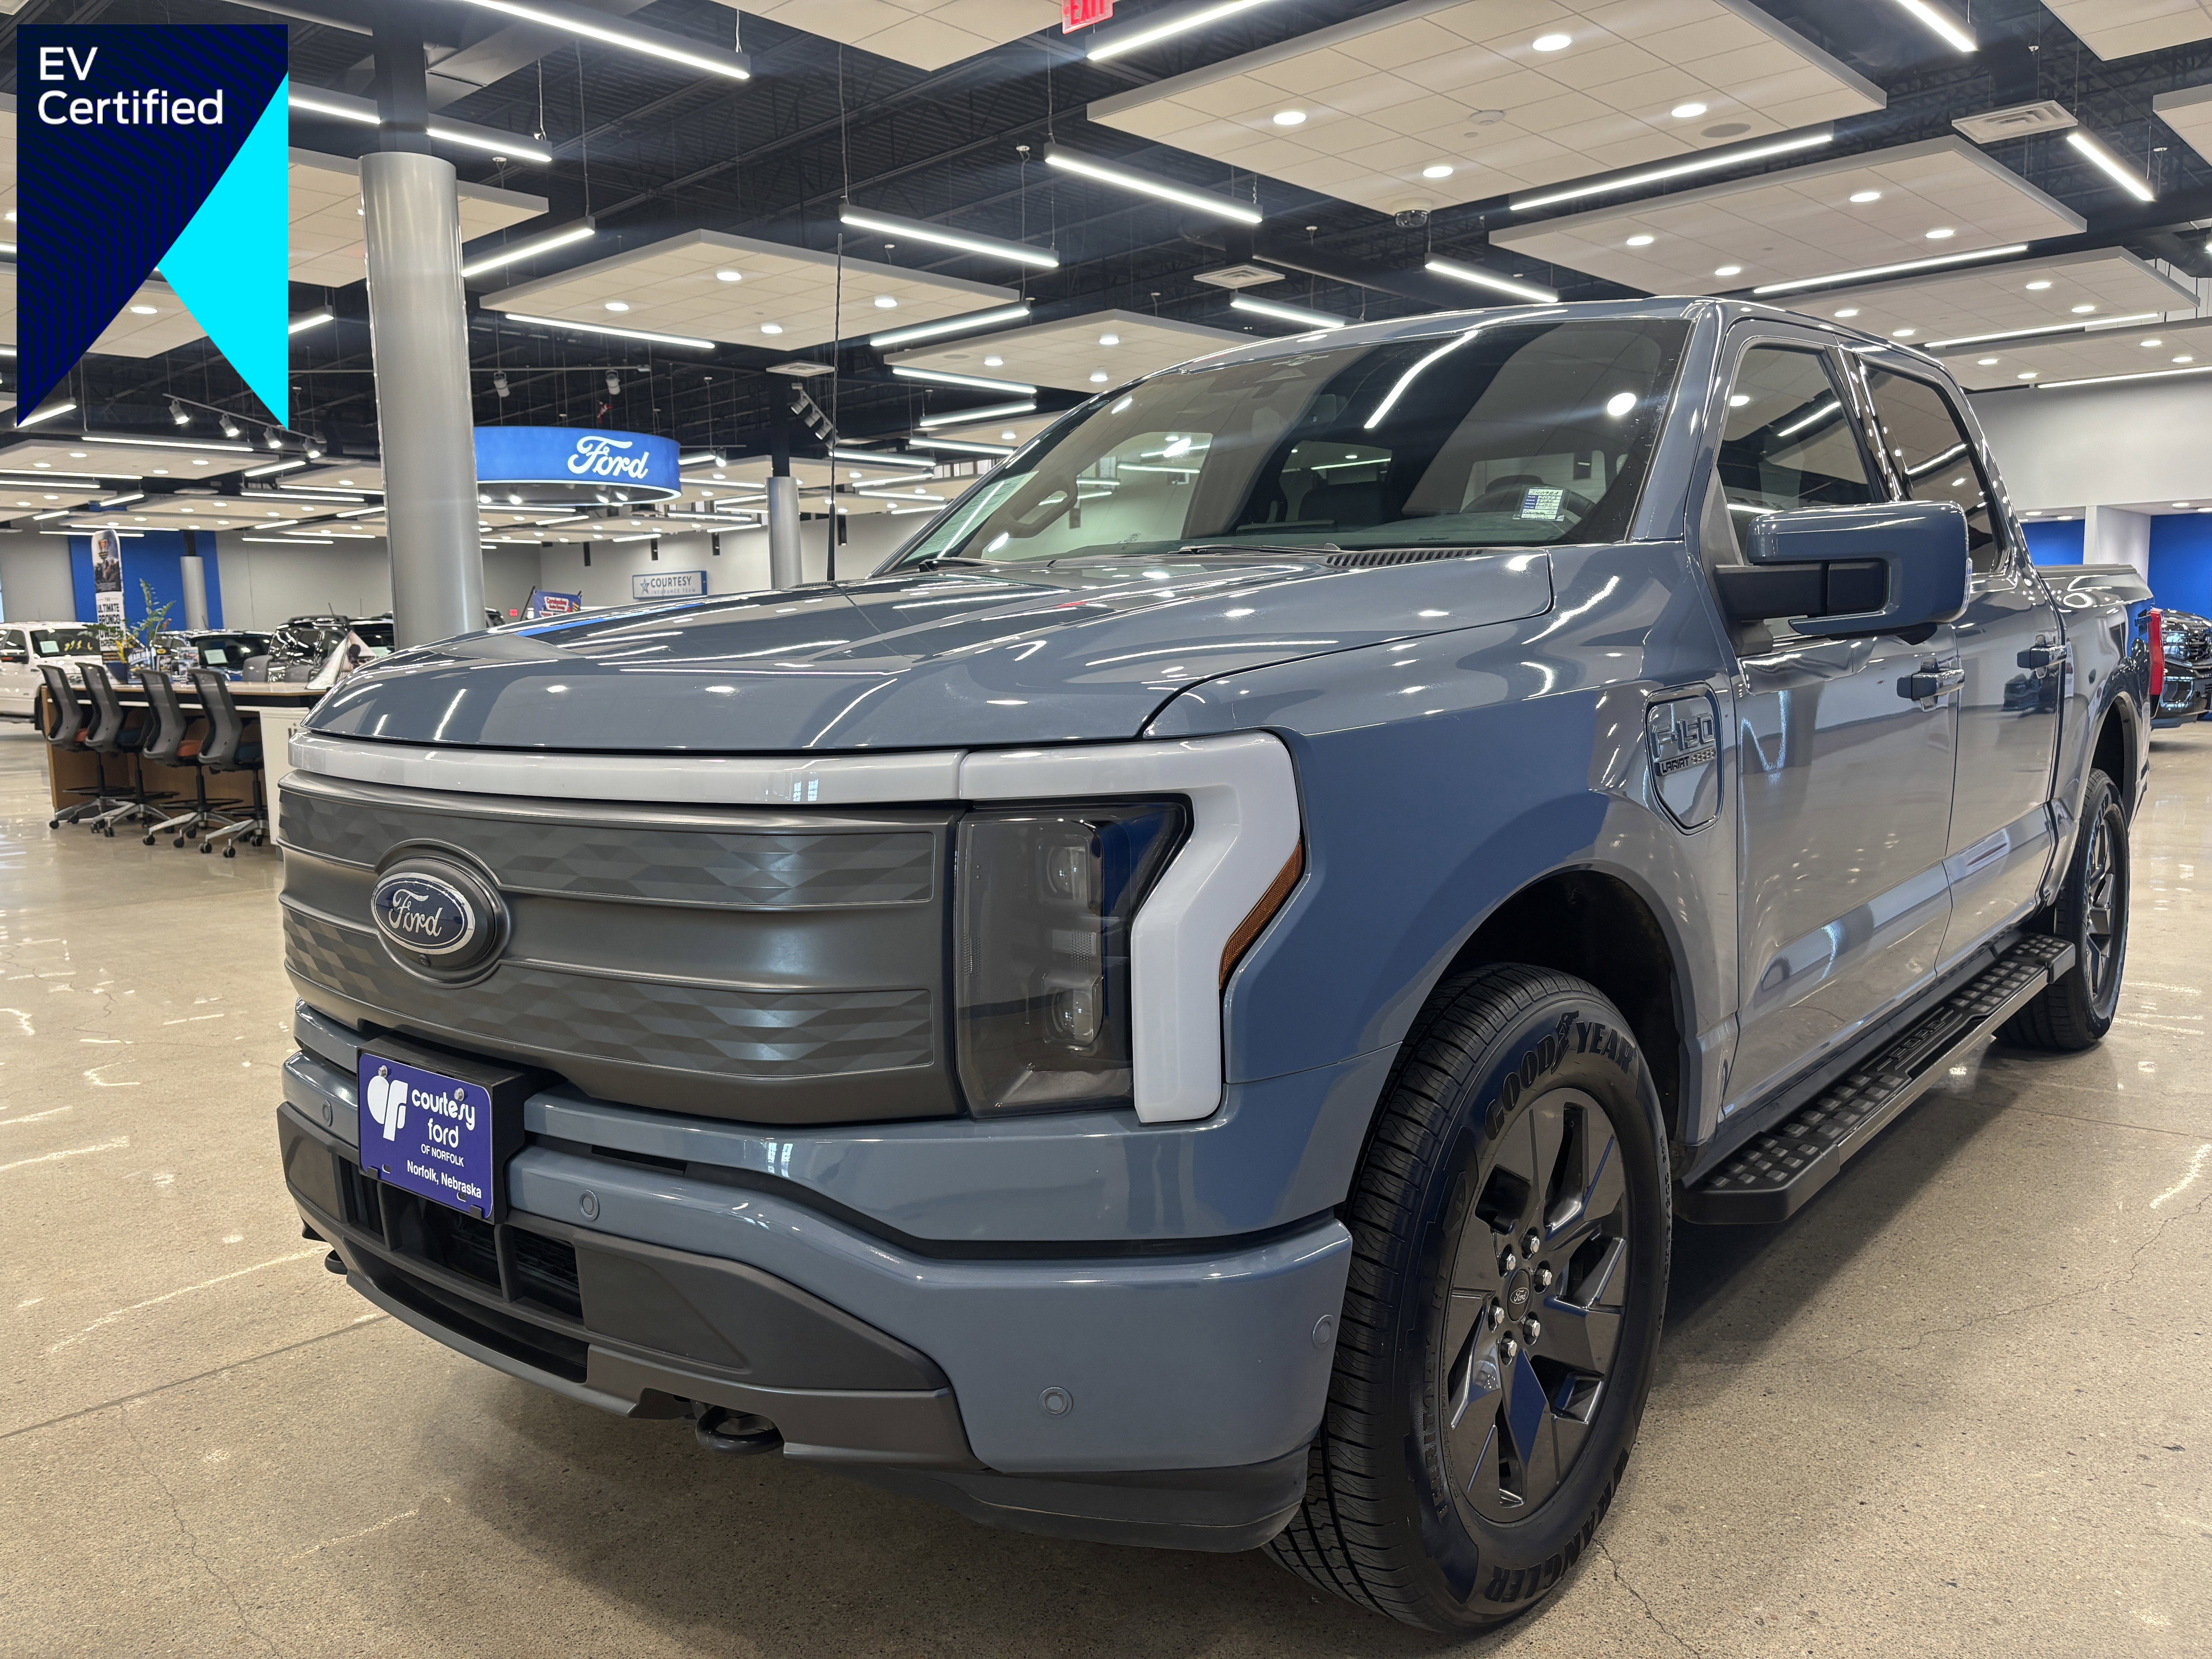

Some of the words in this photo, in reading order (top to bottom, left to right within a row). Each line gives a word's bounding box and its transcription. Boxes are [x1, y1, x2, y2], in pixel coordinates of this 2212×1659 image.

[567, 436, 649, 479] Ford
[650, 576, 692, 588] COURTESY
[1662, 756, 1690, 773] LARIAT
[388, 889, 443, 937] Ford
[411, 1089, 475, 1131] courtesy
[428, 1118, 459, 1148] ford
[421, 1143, 430, 1155] OF
[431, 1147, 464, 1167] NORFOLK
[407, 1159, 439, 1185] Norfolk,
[441, 1171, 482, 1199] Nebraska
[1514, 1290, 1527, 1302] Ford
